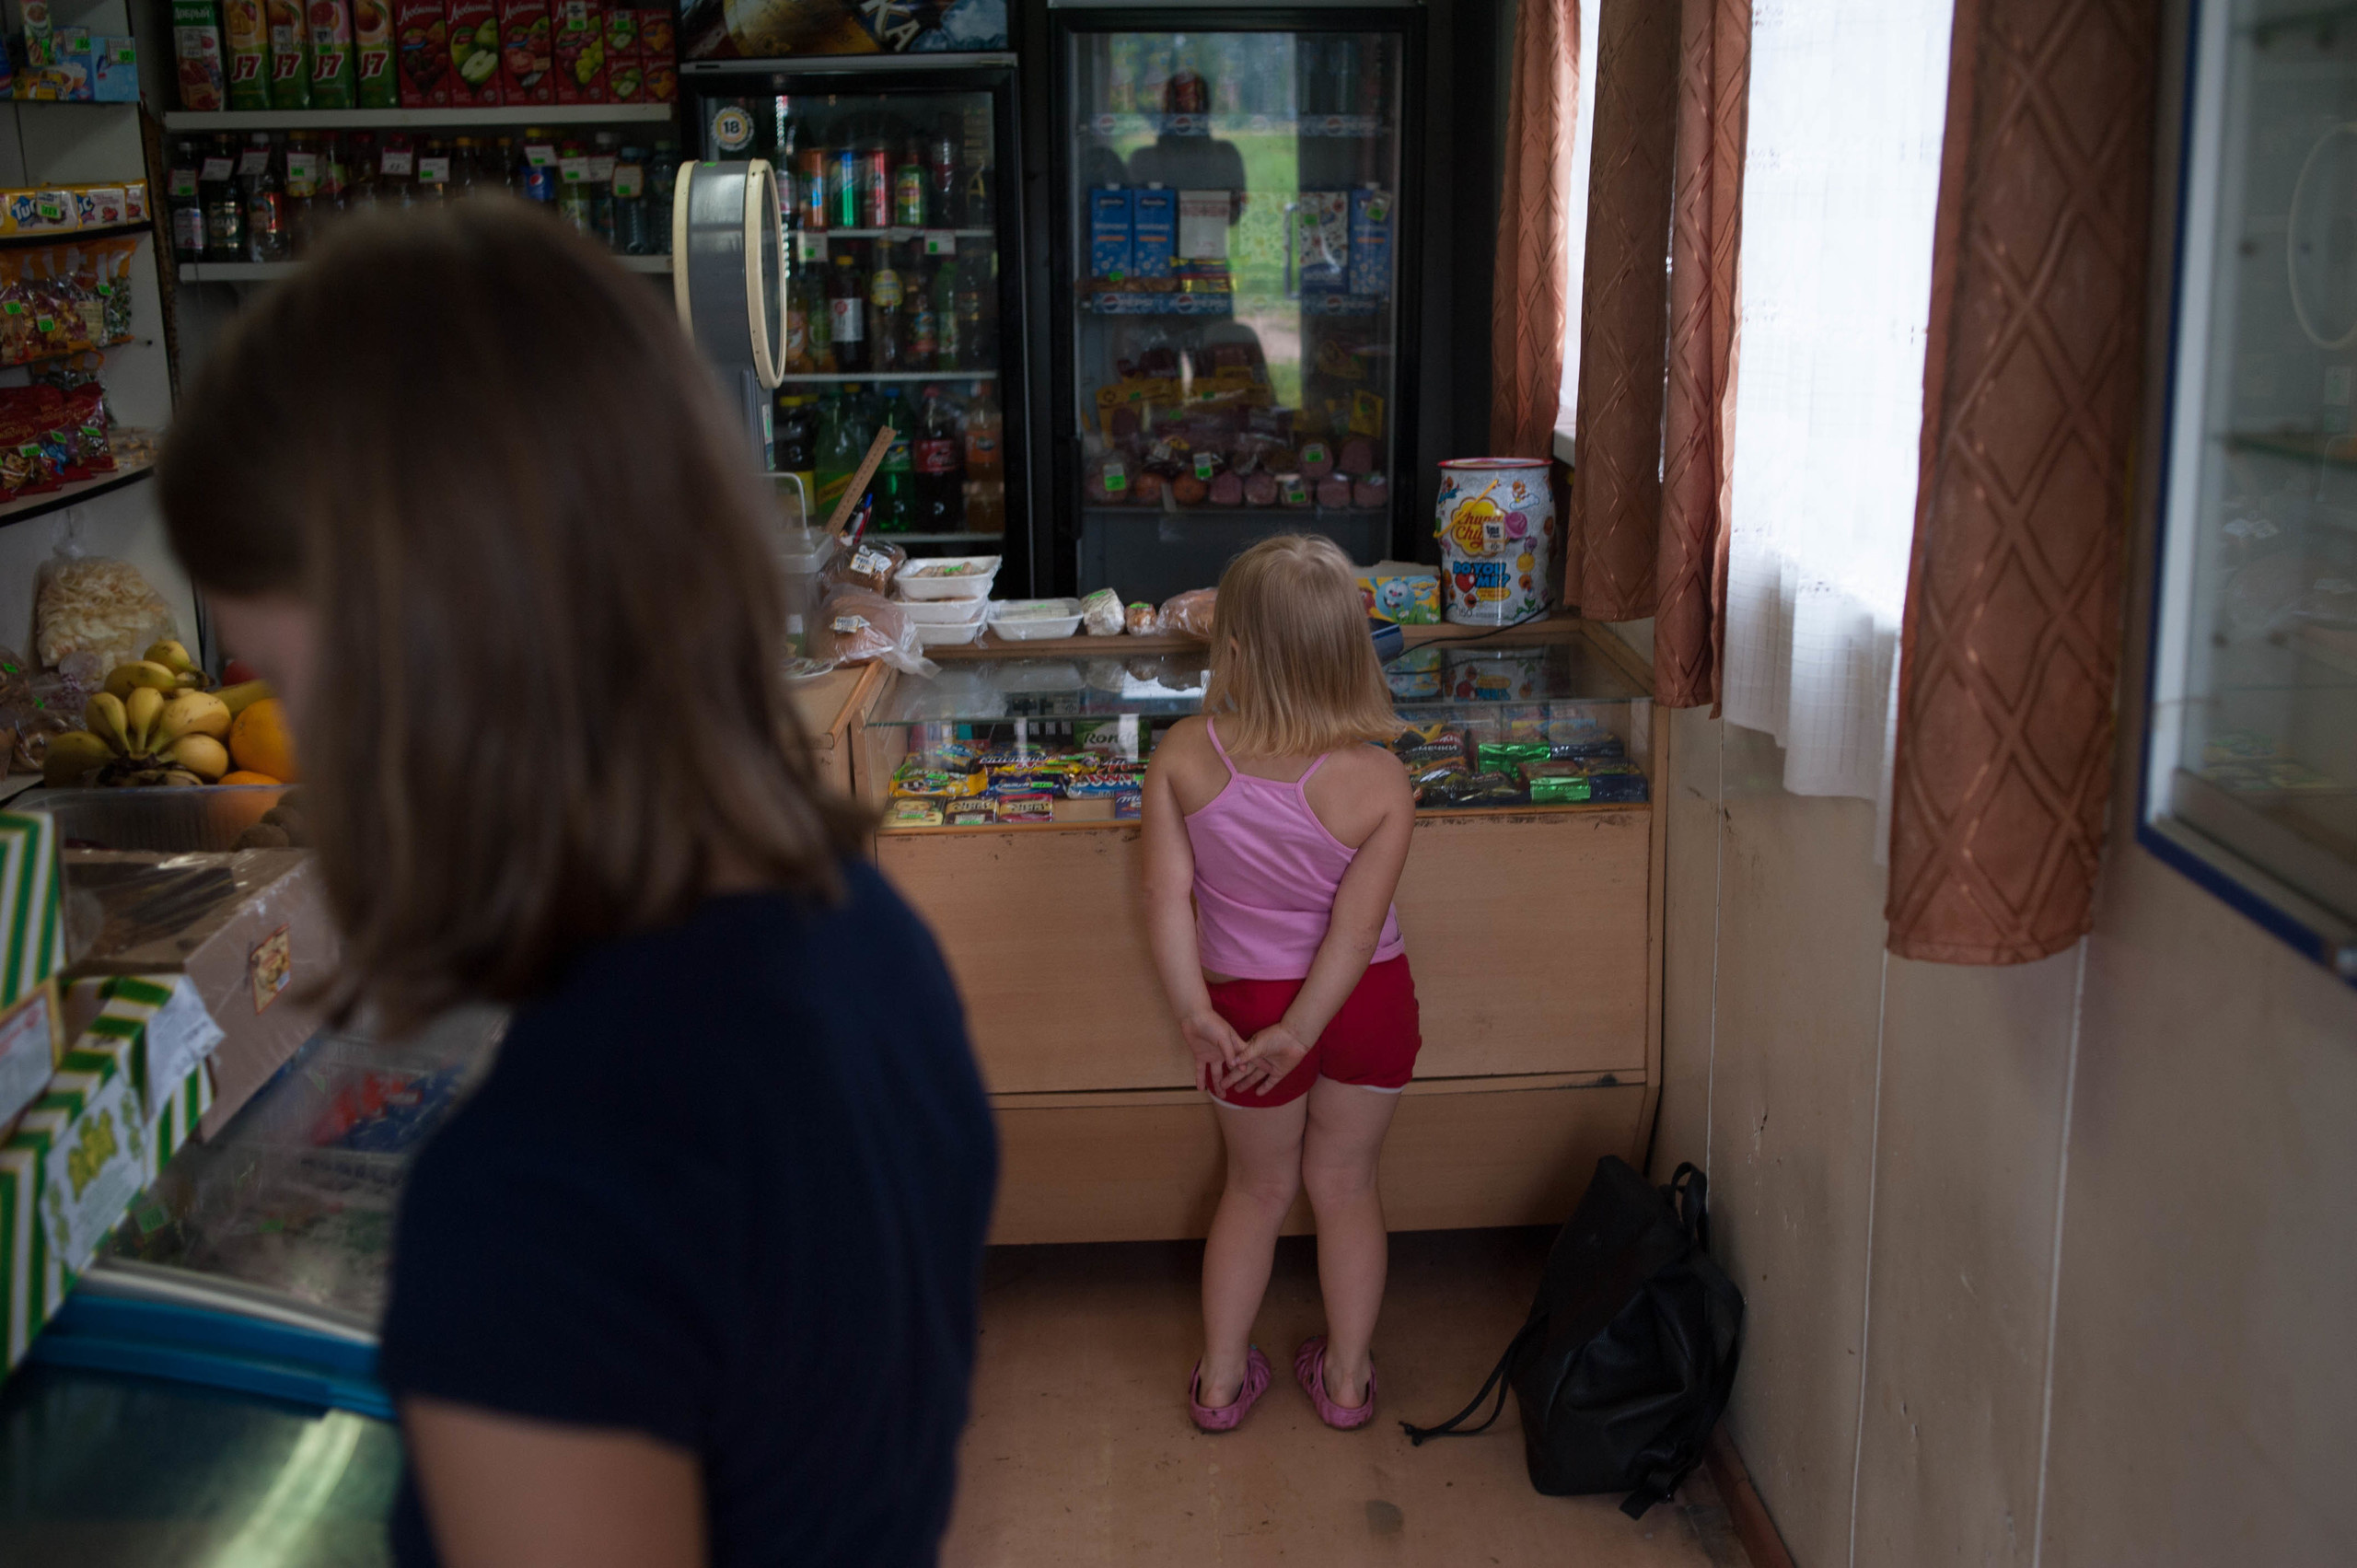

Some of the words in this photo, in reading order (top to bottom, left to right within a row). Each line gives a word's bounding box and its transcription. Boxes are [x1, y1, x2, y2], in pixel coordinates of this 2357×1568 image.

[231, 54, 262, 81] J7
[272, 53, 301, 80] J7
[313, 53, 343, 81] J7
[360, 52, 389, 79] J7
[723, 121, 740, 134] 18
[1456, 526, 1484, 549] Chu
[1452, 561, 1472, 575] DO
[1472, 562, 1507, 575] YOU
